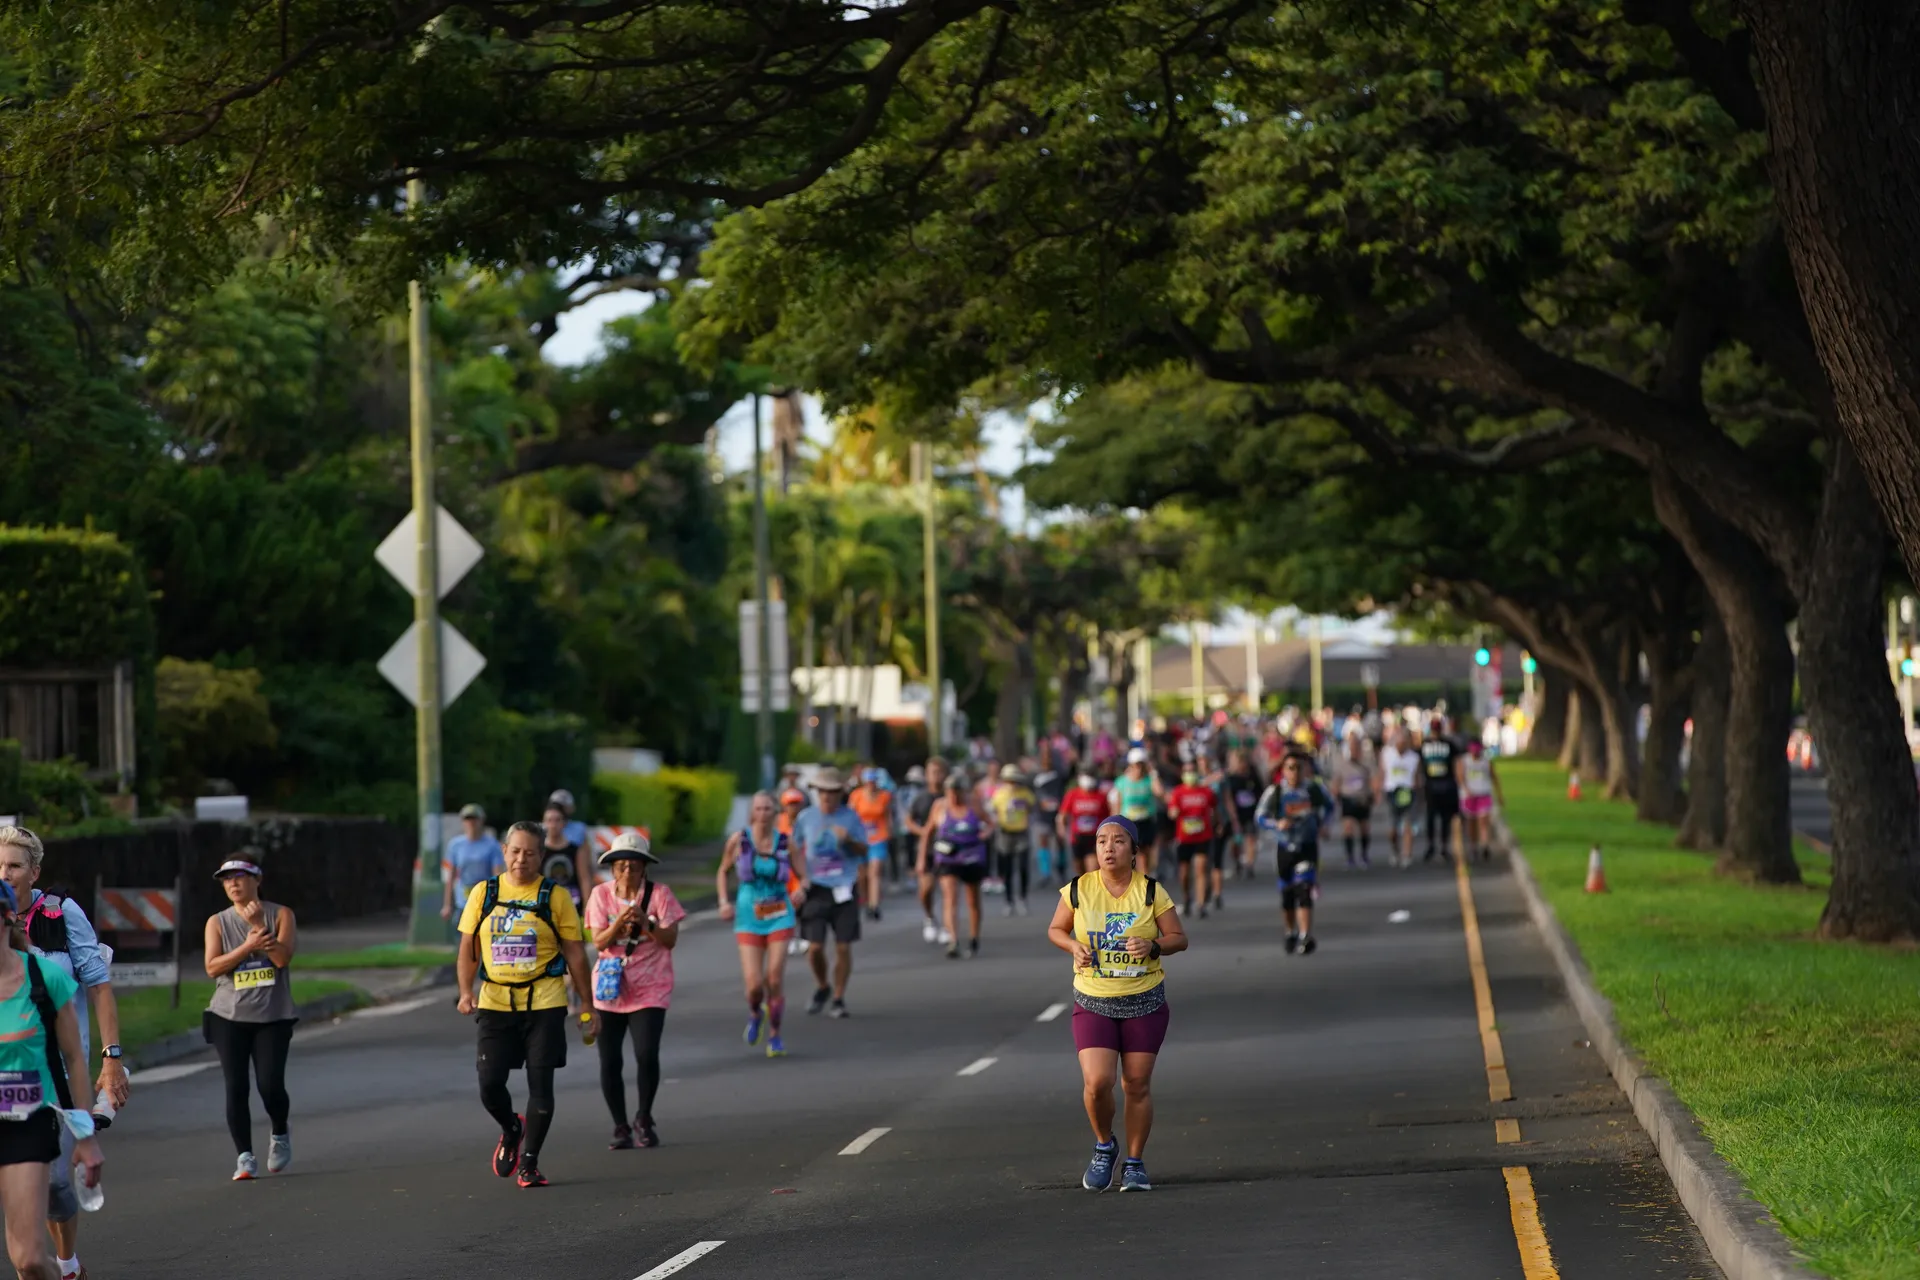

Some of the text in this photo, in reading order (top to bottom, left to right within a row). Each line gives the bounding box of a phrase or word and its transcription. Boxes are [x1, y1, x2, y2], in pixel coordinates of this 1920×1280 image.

[495, 946, 533, 957] 14571
[237, 969, 274, 982] 17108
[0, 1086, 40, 1103] 908
